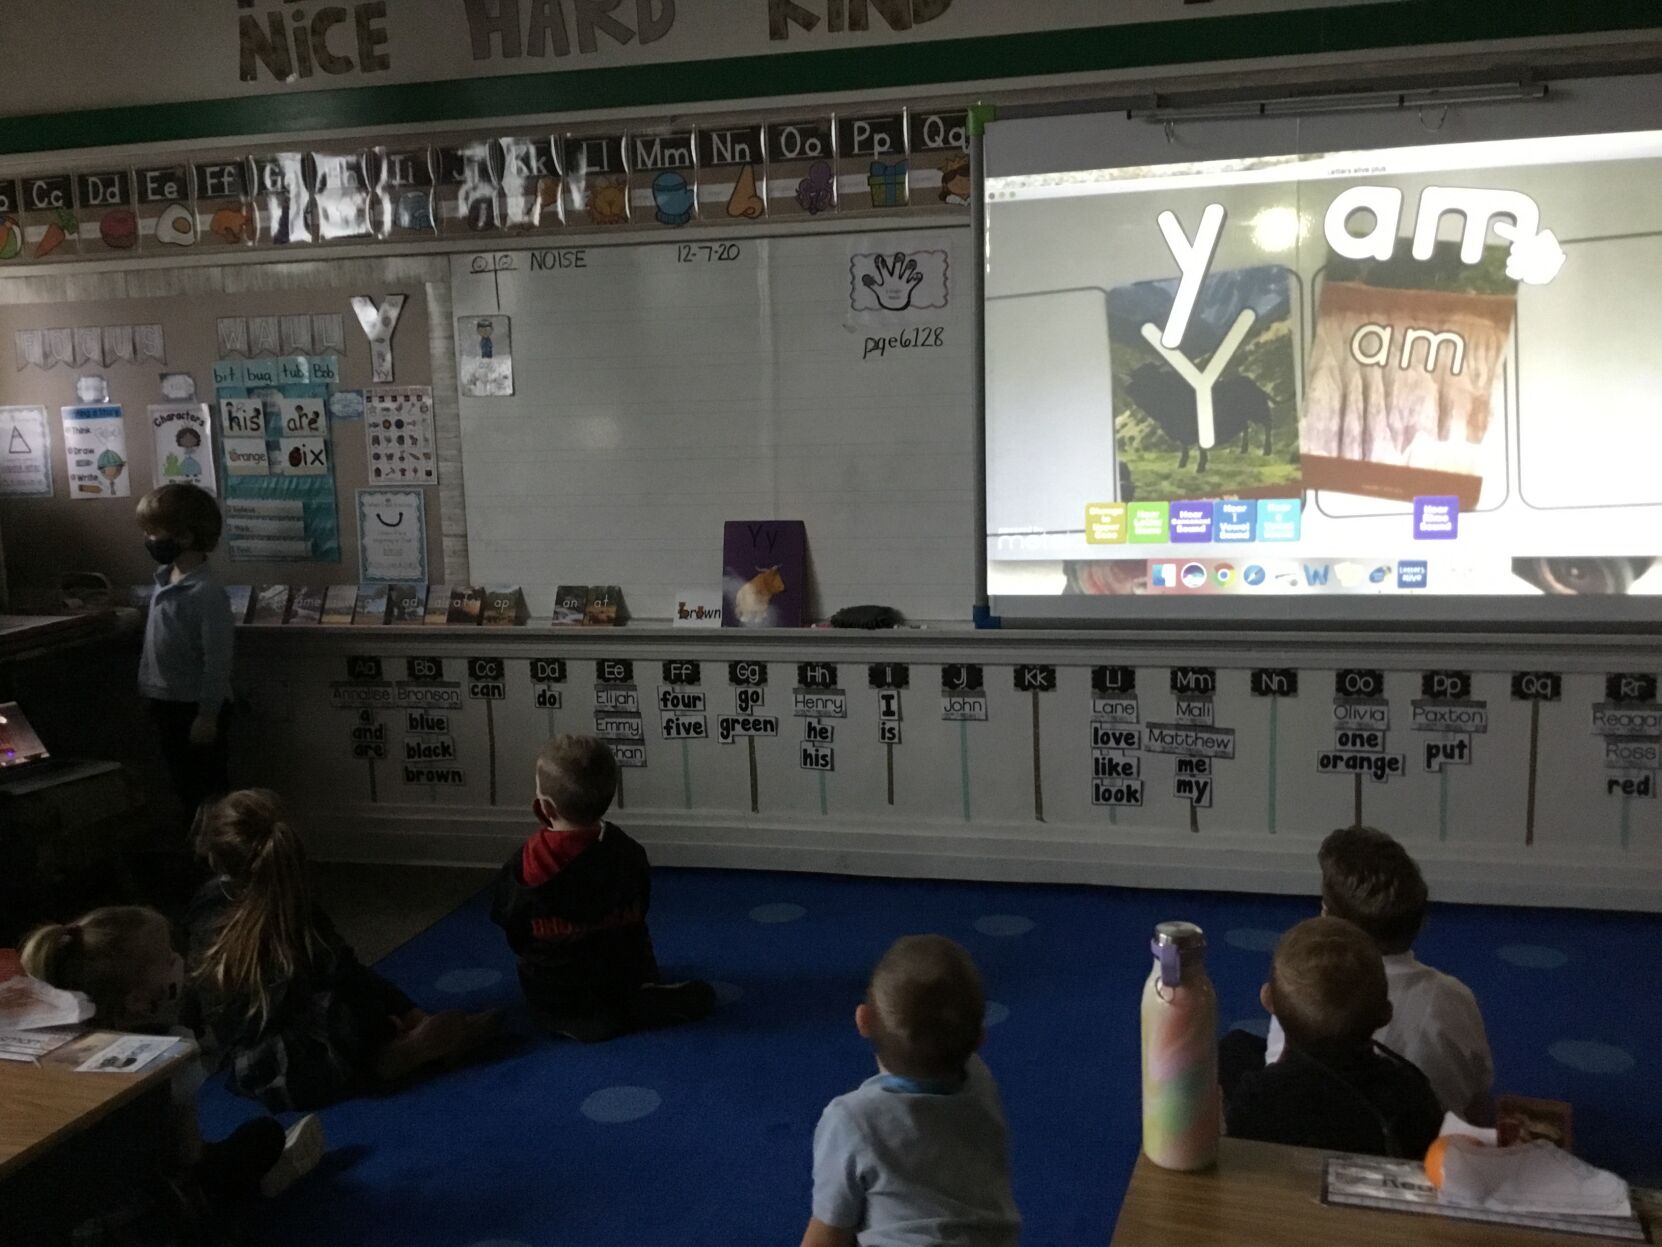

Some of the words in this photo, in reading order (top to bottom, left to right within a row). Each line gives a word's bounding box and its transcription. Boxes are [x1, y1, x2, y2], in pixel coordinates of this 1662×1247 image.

[33, 181, 64, 208] Cc
[89, 175, 121, 205] Dd
[146, 171, 178, 200] Ee
[206, 167, 236, 196] Ff
[637, 138, 690, 170] Mm
[712, 131, 750, 163] Nn
[780, 126, 821, 158] Oo
[854, 121, 892, 160] Pp
[1324, 184, 1540, 265] am
[530, 250, 587, 271] NOISE
[221, 319, 337, 350] WALL
[1350, 322, 1466, 376] am
[213, 366, 235, 383] bit
[283, 363, 305, 379] tub
[312, 363, 335, 379] Bob
[1141, 308, 1256, 449] Y
[153, 410, 205, 427] Characters
[227, 403, 261, 432] his
[287, 405, 320, 432] are
[747, 524, 778, 553] Yy
[494, 599, 510, 613] ap
[562, 599, 578, 608] an
[593, 595, 609, 608] at
[678, 602, 721, 620] brown
[414, 661, 435, 676] Bb
[476, 662, 497, 677] Cc
[537, 662, 559, 678] Dd
[604, 663, 624, 678] Ee
[669, 663, 692, 681] Ff
[736, 663, 760, 683] Gg
[807, 665, 830, 683] Hh
[1024, 670, 1049, 687] Kk
[1176, 671, 1212, 690] Mm
[1261, 674, 1287, 691] Nn
[1344, 673, 1374, 692] Oo
[1433, 675, 1462, 694] Pp
[1521, 675, 1552, 698] Qq
[398, 687, 459, 701] Bronson
[470, 683, 501, 698] can
[1620, 679, 1647, 697] Rr
[537, 690, 557, 707] do
[596, 690, 635, 708] Elijah
[660, 690, 702, 709] four
[738, 690, 760, 712] go
[794, 694, 844, 713] Henry
[881, 694, 896, 717] I
[943, 698, 983, 713] John
[1092, 699, 1135, 715] Lane
[361, 711, 371, 722] a
[1333, 704, 1385, 720] Olivia
[1412, 705, 1484, 723] Paxton
[408, 713, 446, 731] blue
[596, 717, 640, 736] Emmy
[663, 718, 704, 736] five
[719, 715, 775, 739] green
[807, 722, 829, 740] he
[353, 724, 383, 741] and
[880, 722, 897, 741] is
[1093, 727, 1136, 747] love
[1149, 729, 1231, 750] Matthew
[1338, 732, 1379, 748] one
[354, 743, 383, 757] are
[405, 740, 453, 760] black
[802, 749, 830, 768] his
[1426, 740, 1467, 768] put
[1094, 757, 1134, 777] like
[1177, 758, 1207, 773] me
[1319, 754, 1400, 780] orange
[404, 766, 462, 784] brown
[1094, 785, 1140, 803] look
[1176, 780, 1209, 803] my
[1607, 775, 1650, 796] red
